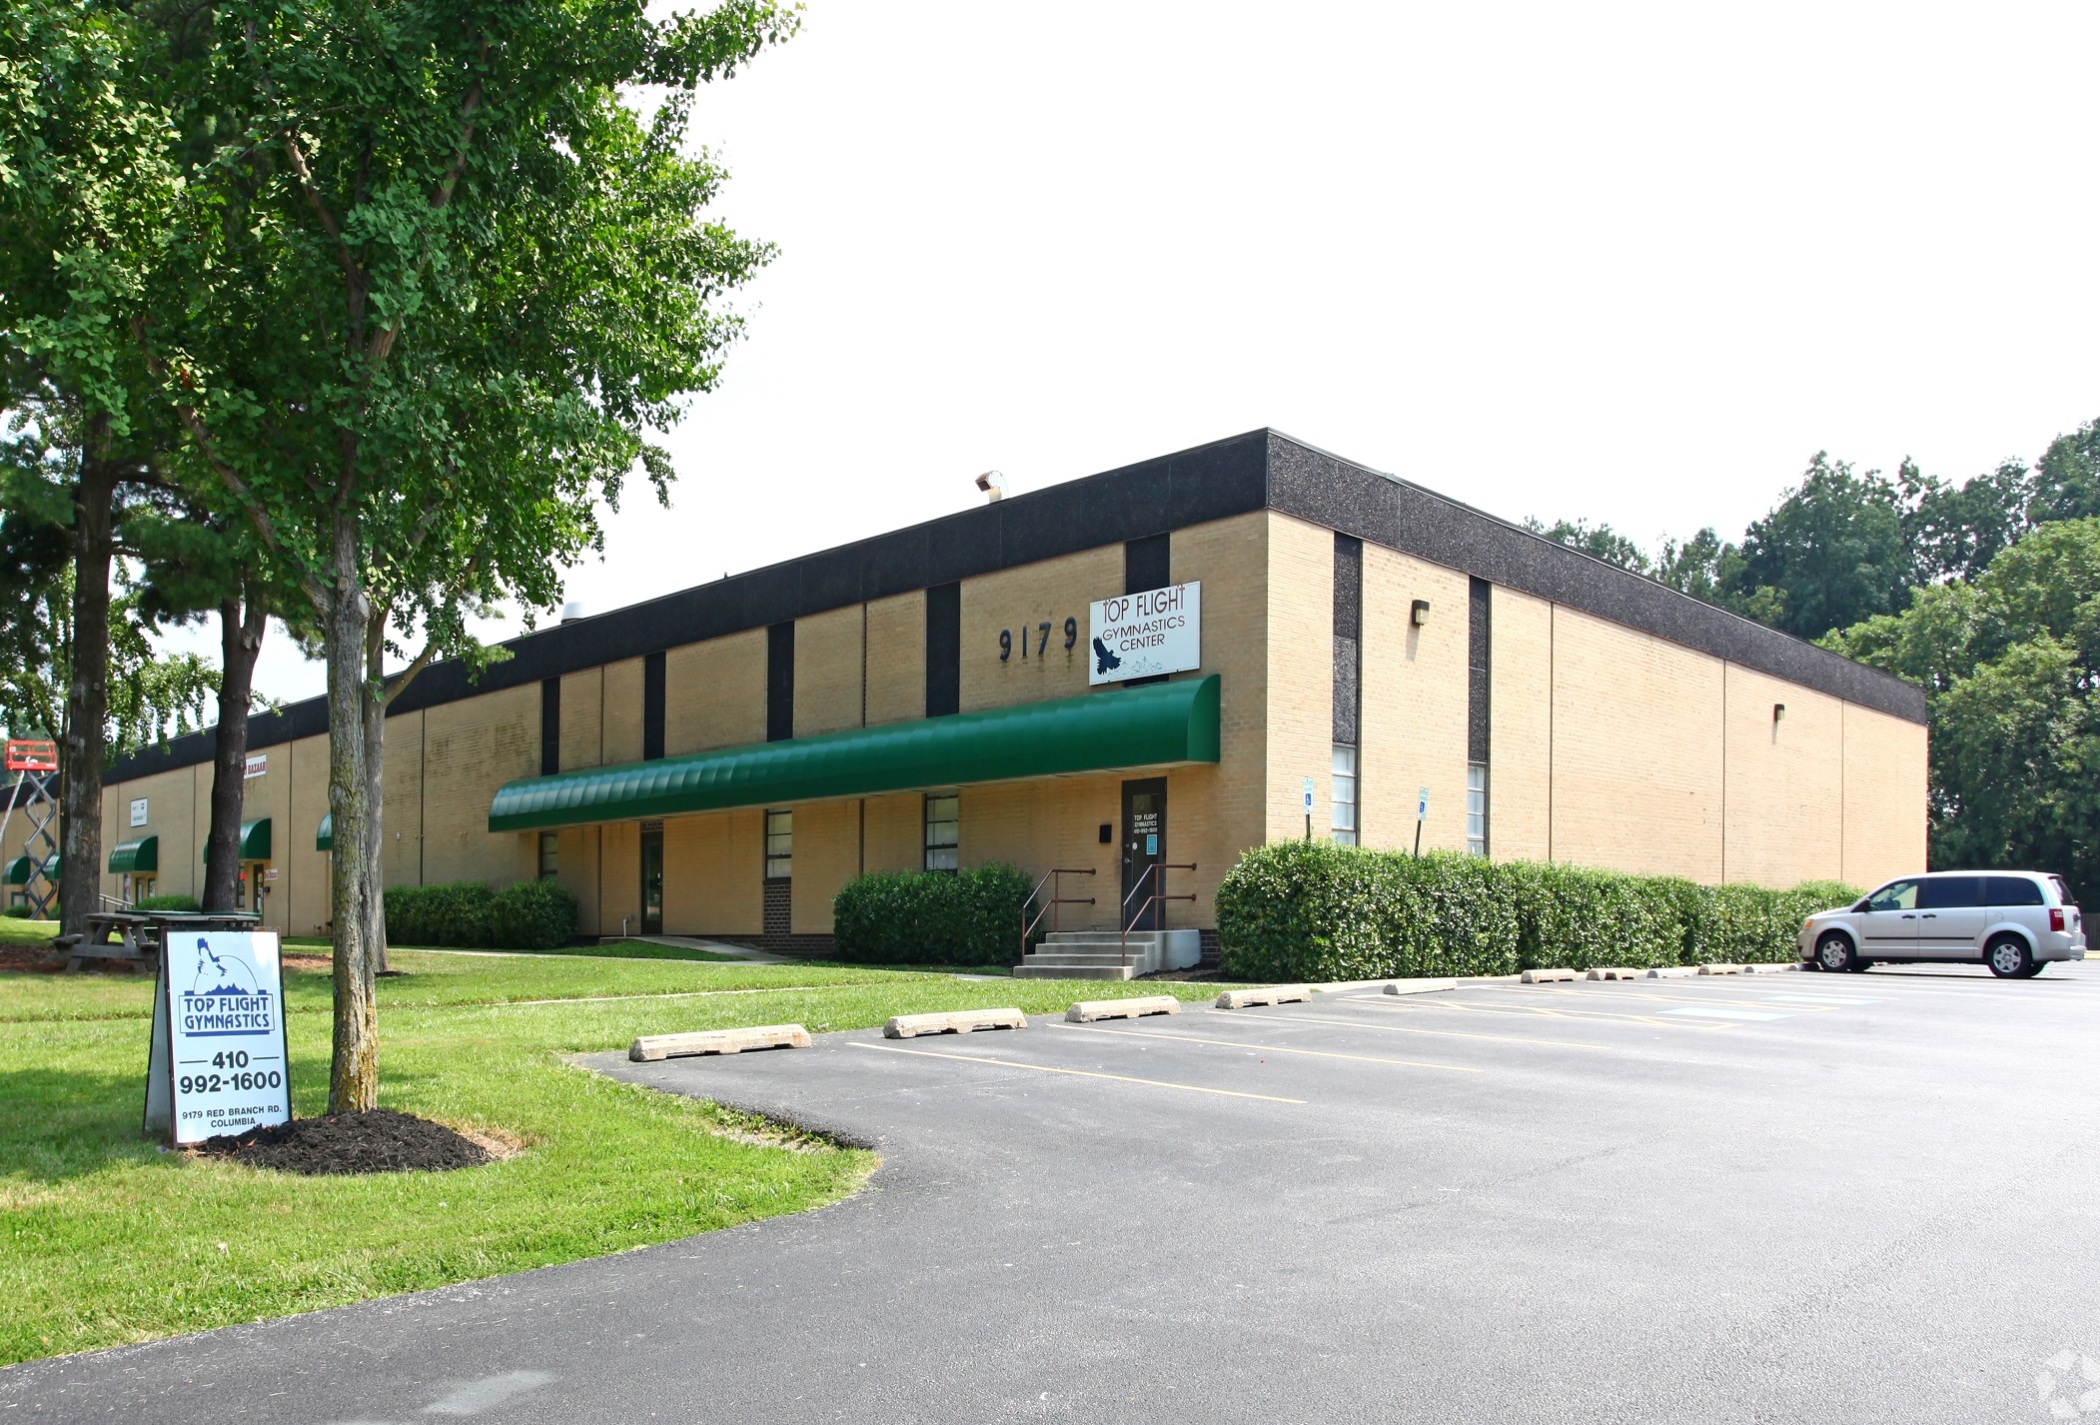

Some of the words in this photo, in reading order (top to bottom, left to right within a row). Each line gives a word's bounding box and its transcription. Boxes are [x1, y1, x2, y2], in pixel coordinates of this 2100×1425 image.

[1102, 598, 1129, 624] TOP
[1136, 584, 1186, 617] FLIGHT
[1102, 615, 1185, 641] GYMNASTICS
[999, 616, 1078, 661] 9179
[1120, 633, 1165, 652] CENTER
[248, 761, 266, 775] BAZAAR
[1134, 820, 1157, 828] GYMNASTICS
[184, 998, 215, 1012] TOP
[220, 997, 269, 1012] FLIGHT
[184, 1013, 270, 1030] GYMNASTICS
[212, 1050, 249, 1069] 410
[179, 1071, 281, 1094] 992-1600
[182, 1110, 203, 1120] 9179
[206, 1108, 225, 1118] RED
[228, 1106, 265, 1116] BRANCH
[268, 1104, 282, 1113] RD.
[210, 1117, 256, 1128] COLUMBIA
